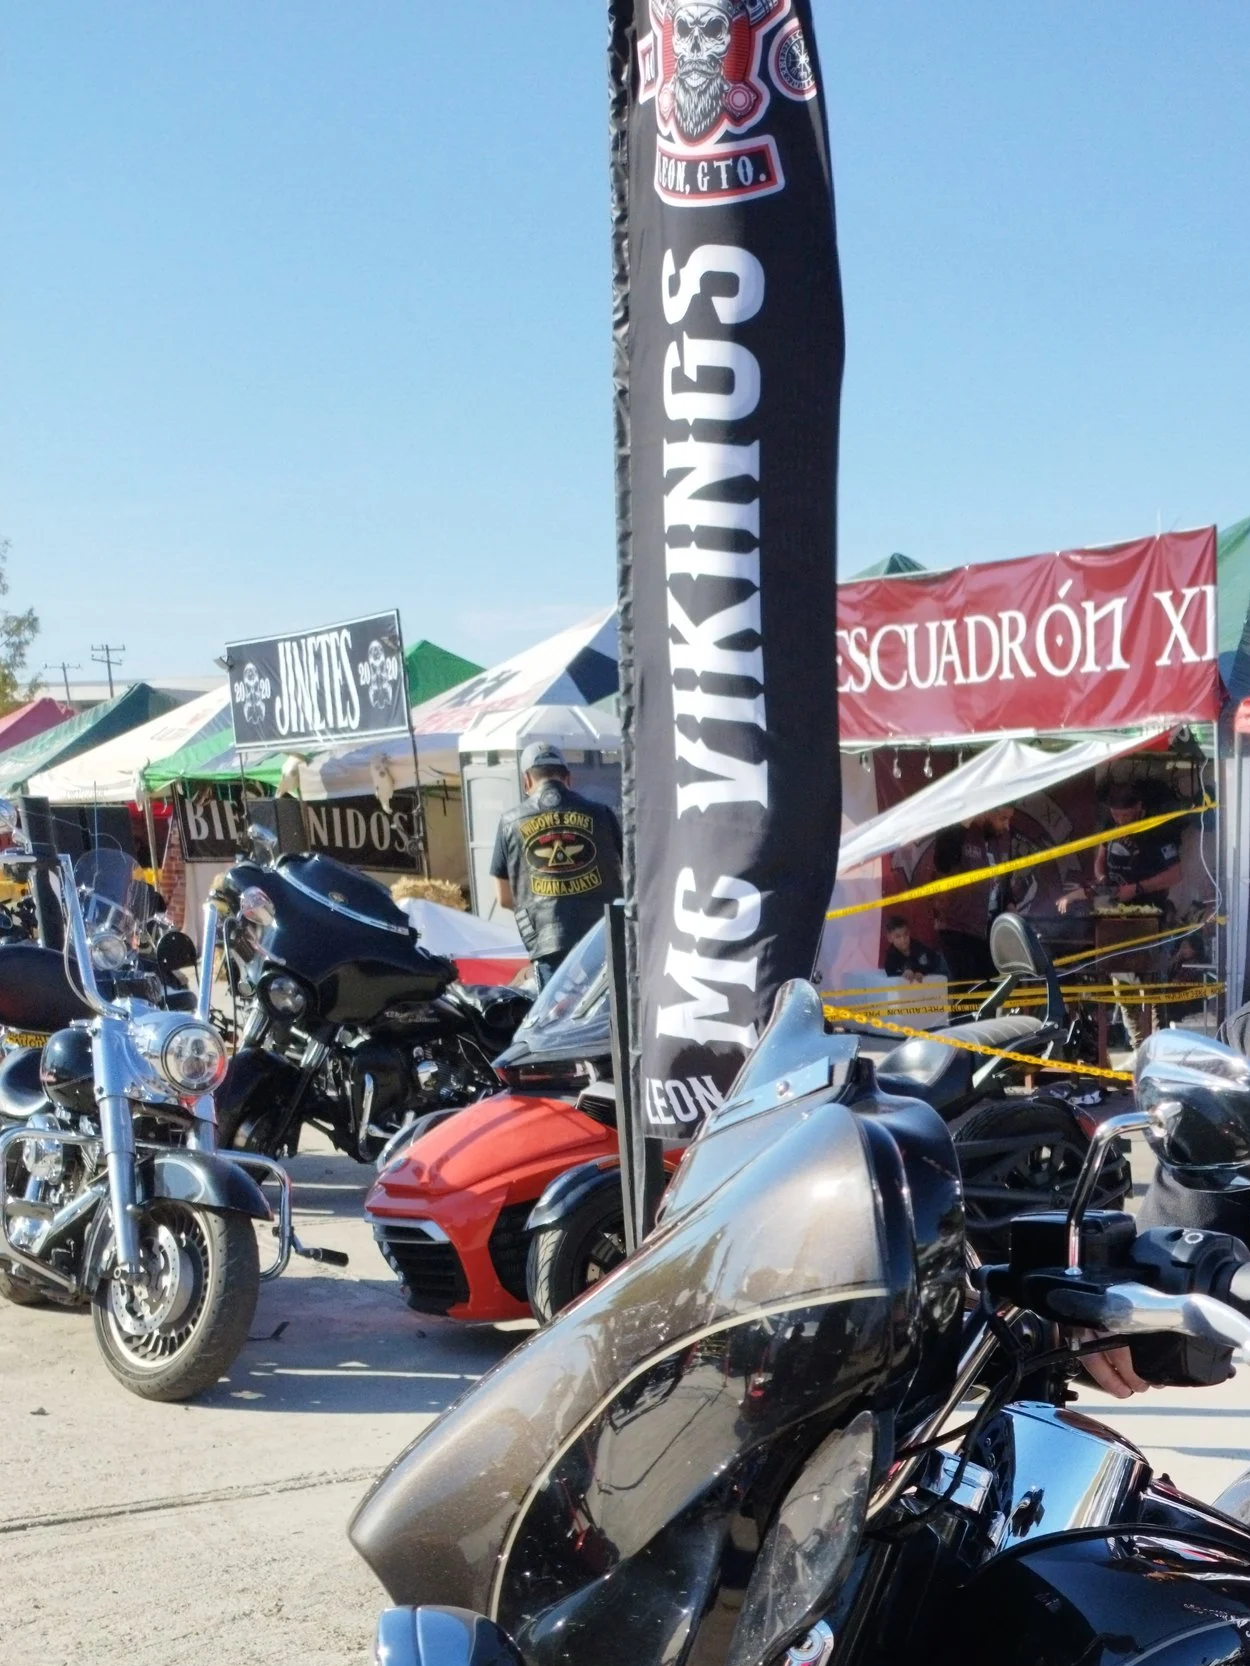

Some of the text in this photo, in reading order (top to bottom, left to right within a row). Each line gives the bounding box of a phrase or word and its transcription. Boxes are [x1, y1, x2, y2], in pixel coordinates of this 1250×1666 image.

[655, 244, 768, 1050] MC VIKINGS
[274, 628, 361, 736] JINETES
[358, 656, 399, 686] 20 20
[234, 678, 272, 703] 20 20
[522, 811, 590, 837] WIDOWS SONS
[534, 873, 599, 894] GUANAJUATO
